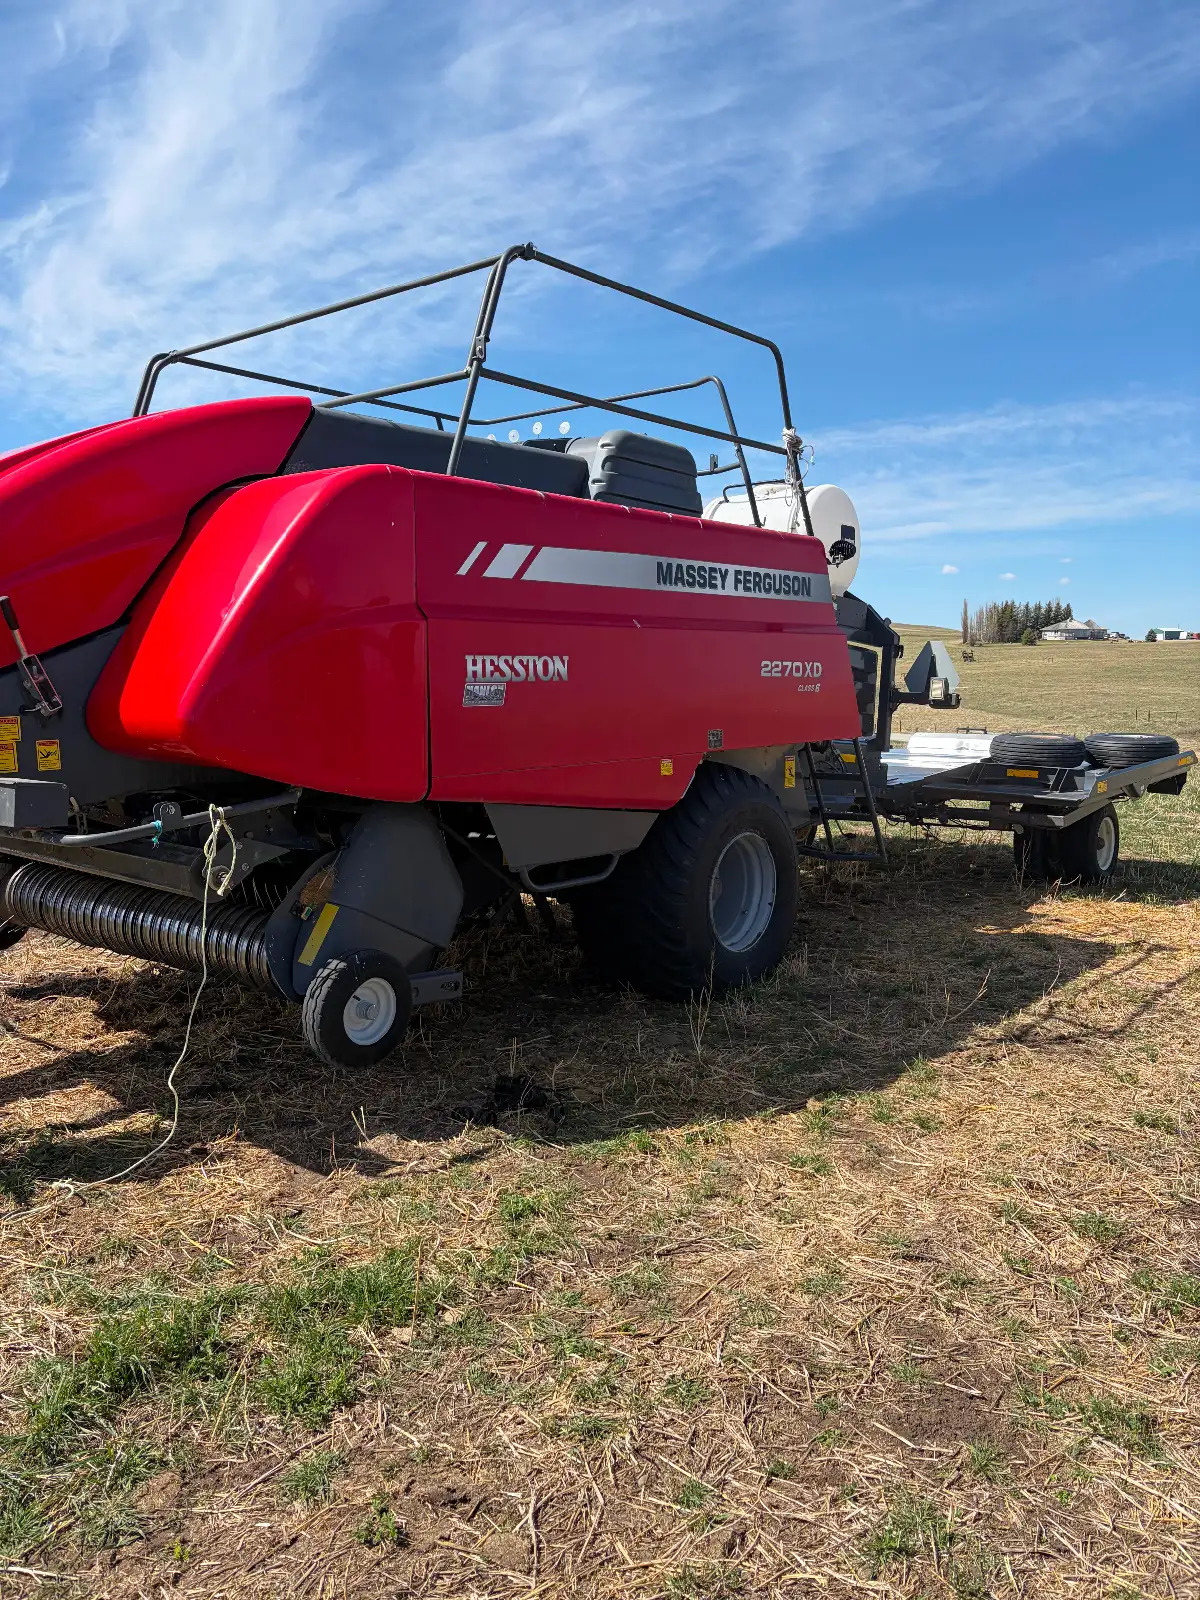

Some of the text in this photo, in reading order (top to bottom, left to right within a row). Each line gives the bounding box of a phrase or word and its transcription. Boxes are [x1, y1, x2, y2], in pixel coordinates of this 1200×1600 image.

[656, 561, 811, 597] MASSEY FERGUSON
[465, 655, 569, 682] HESSTON
[761, 660, 823, 678] 2270XD
[797, 683, 821, 693] CLASS 6
